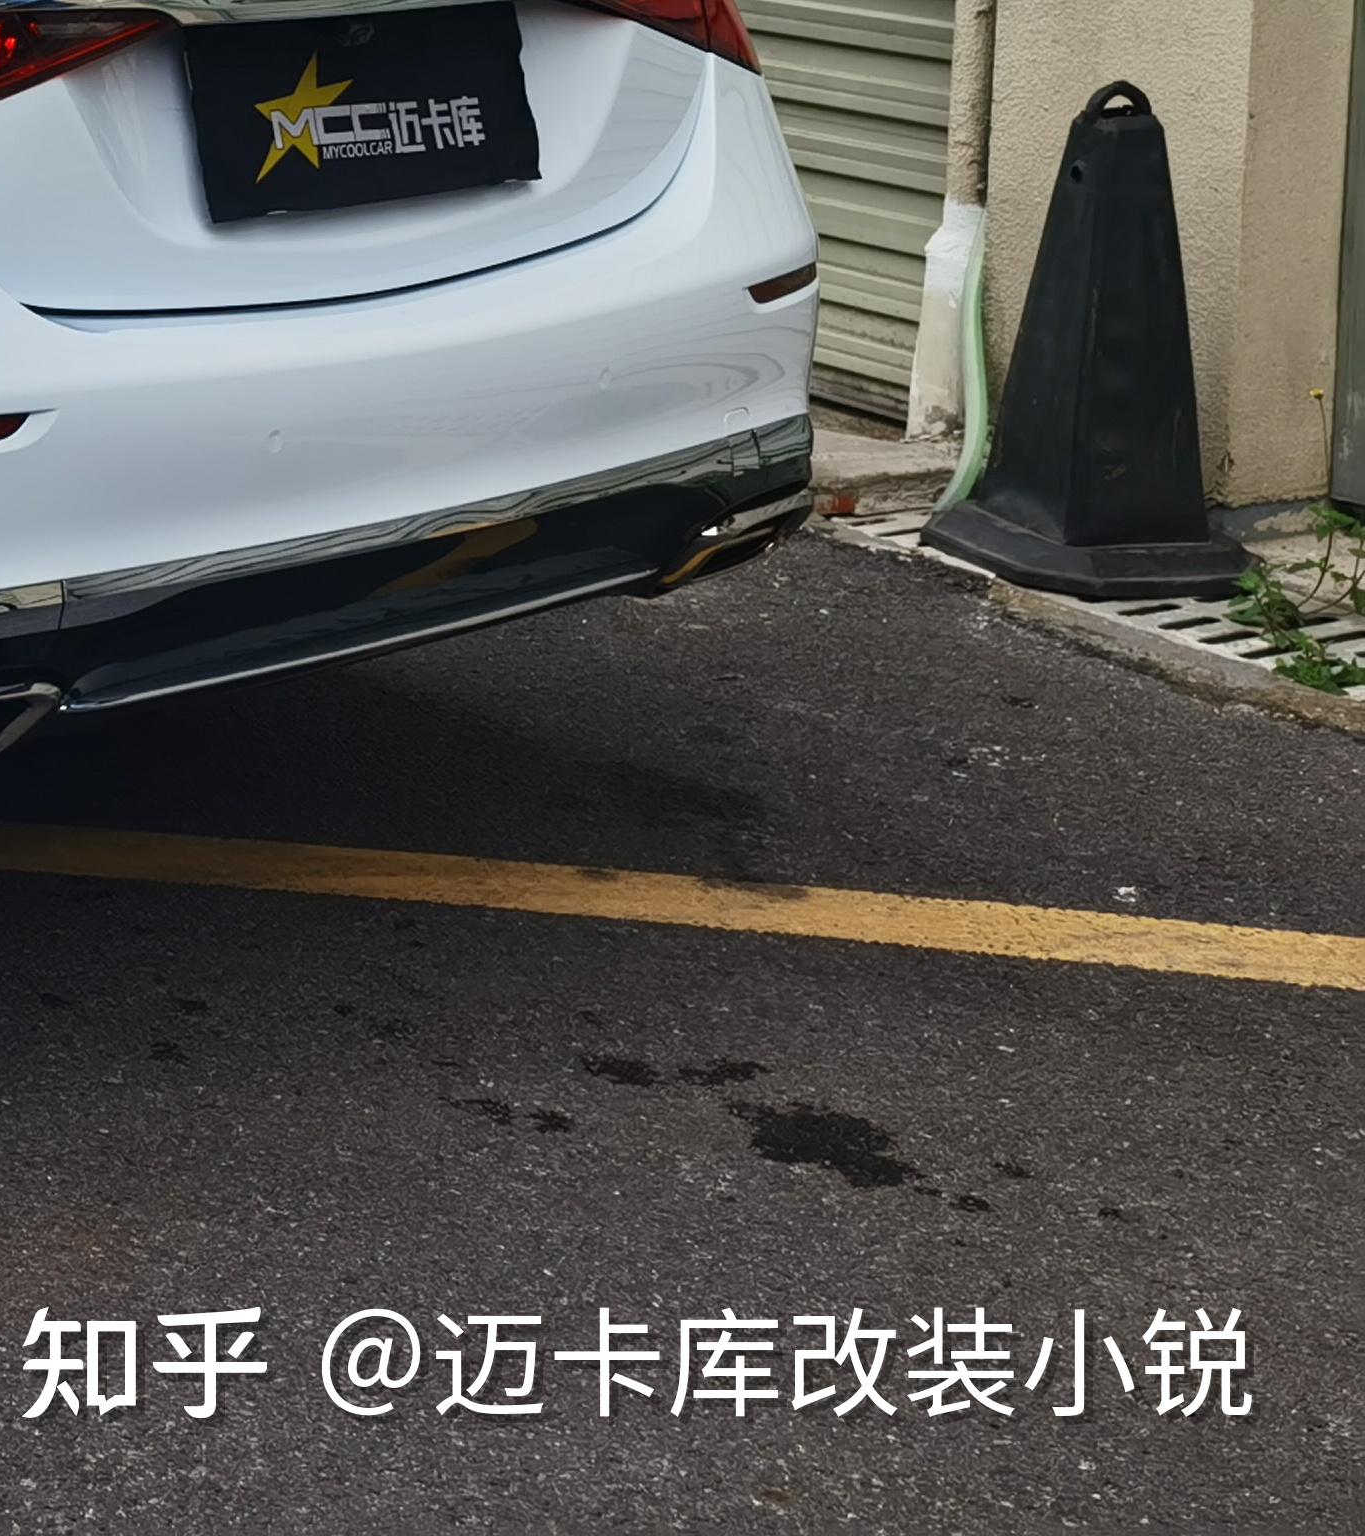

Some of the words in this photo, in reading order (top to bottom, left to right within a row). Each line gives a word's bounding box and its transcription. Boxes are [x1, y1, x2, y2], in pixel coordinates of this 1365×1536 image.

[270, 102, 391, 150] MCC
[388, 95, 486, 153] 迈卡库
[322, 140, 393, 159] MYCOOLCAR
